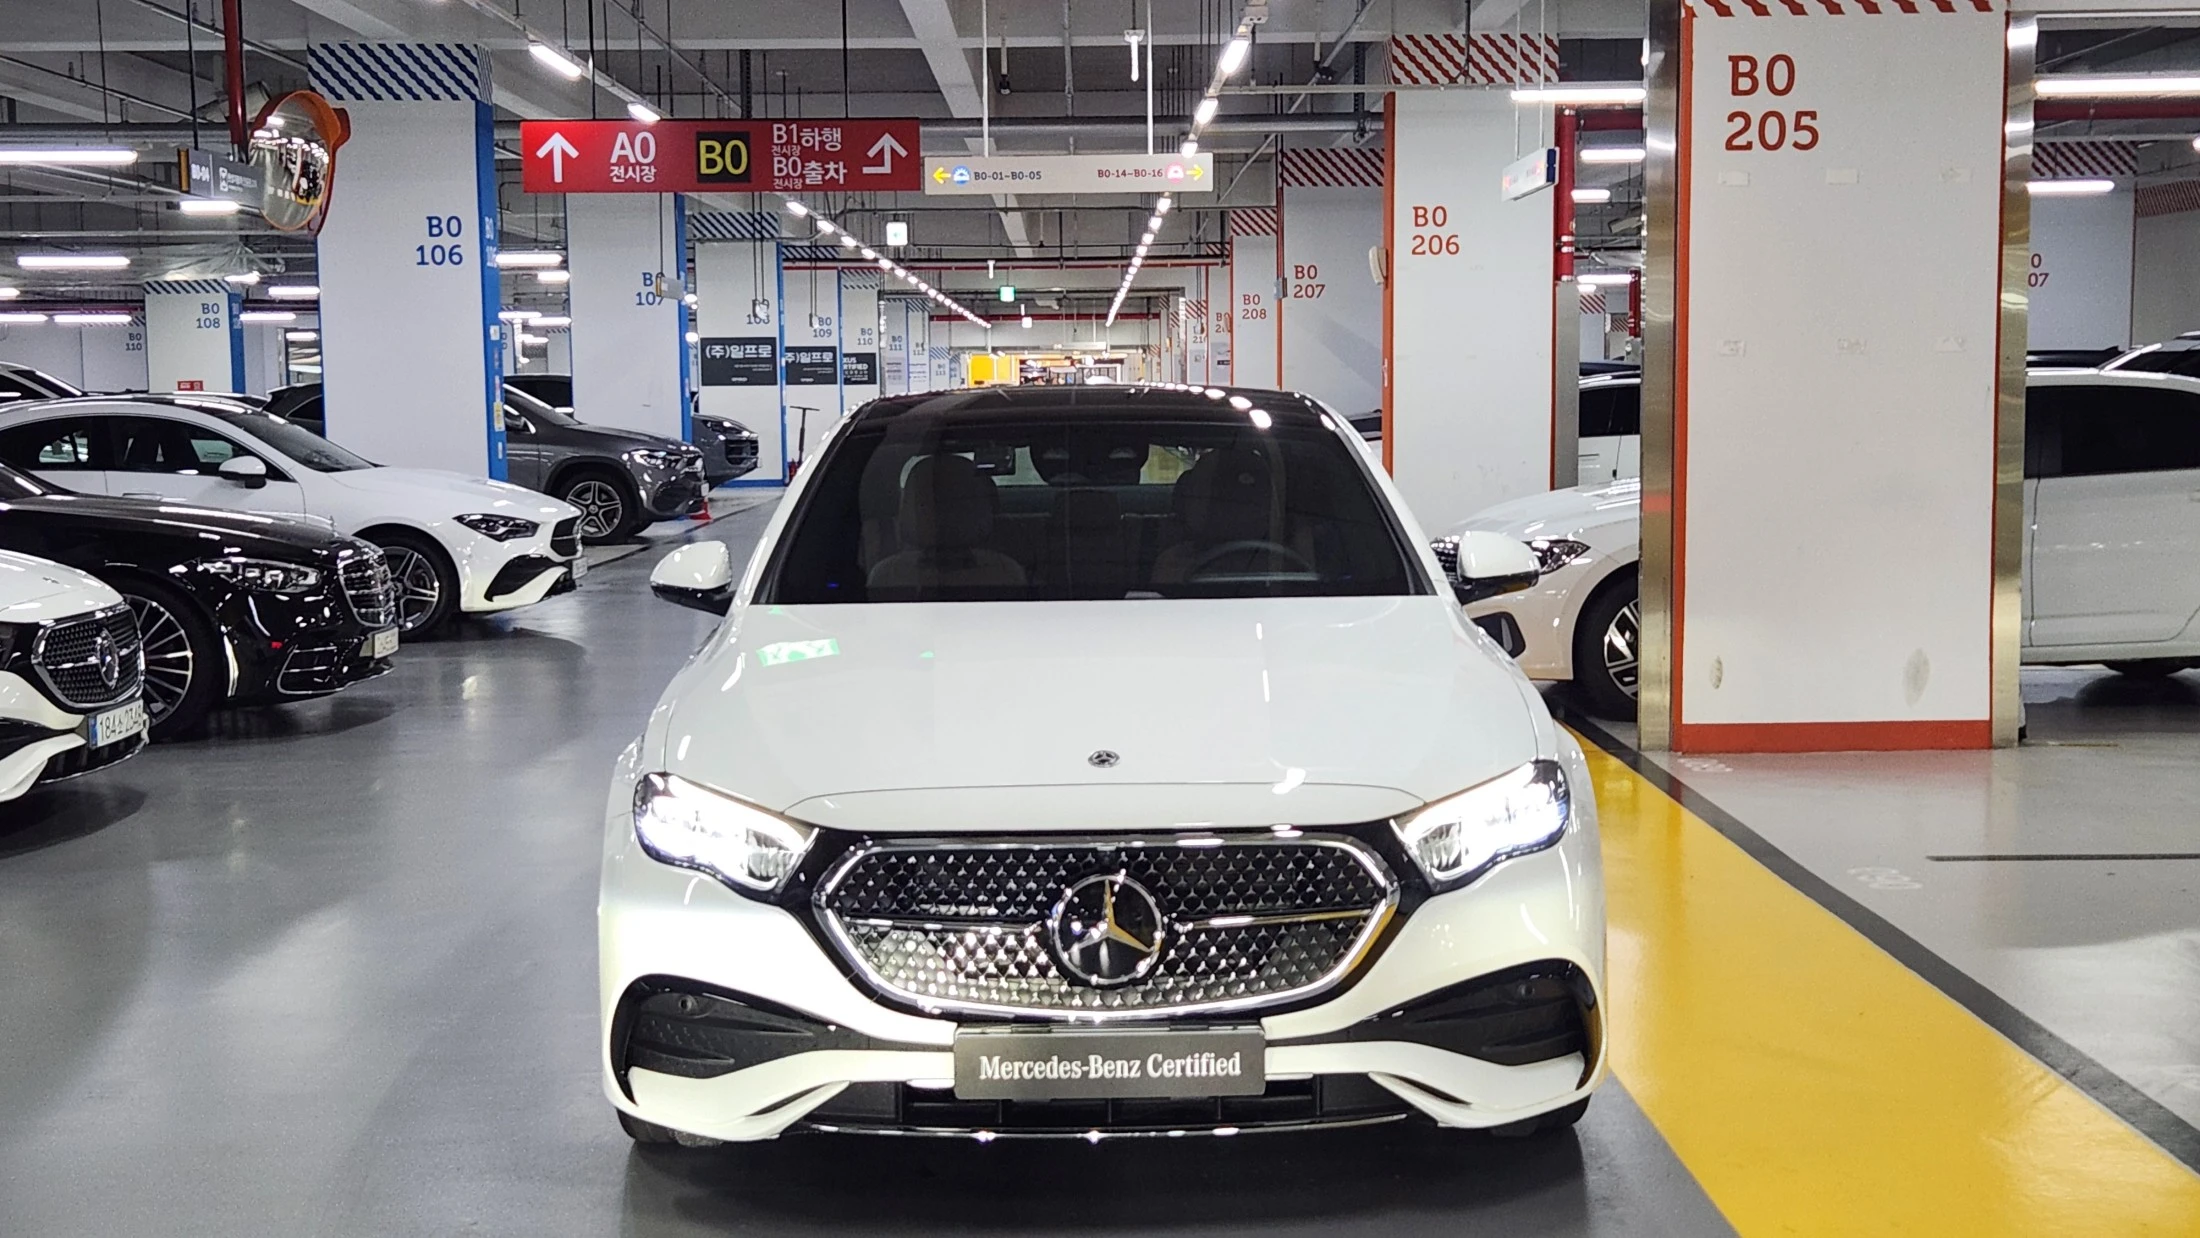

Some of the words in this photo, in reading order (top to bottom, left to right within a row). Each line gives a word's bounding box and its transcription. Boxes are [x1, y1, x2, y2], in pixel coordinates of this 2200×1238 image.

[1728, 54, 1796, 96] B0
[1725, 111, 1820, 151] 205
[610, 131, 656, 164] A0
[771, 144, 801, 157] 전시장
[700, 140, 747, 175] B0
[610, 165, 657, 183] 전시장
[773, 177, 803, 190] 전시장
[1412, 206, 1448, 228] B0
[427, 216, 462, 238] B0
[1411, 235, 1460, 256] 206
[415, 245, 463, 265] 106
[2031, 253, 2042, 268] 0
[1294, 265, 1318, 280] B0
[2027, 272, 2049, 287] 07
[1293, 284, 1326, 299] 207
[1242, 294, 1261, 306] B0
[201, 303, 220, 315] B0
[1242, 308, 1267, 320] 208
[196, 318, 221, 329] 108
[129, 333, 142, 341] B0
[813, 329, 833, 338] 109
[126, 343, 142, 351] 110
[858, 338, 874, 346] 110
[785, 352, 833, 364] 주)일프로
[979, 1054, 1141, 1080] Mercedes-Benz
[1146, 1051, 1241, 1078] Certified
